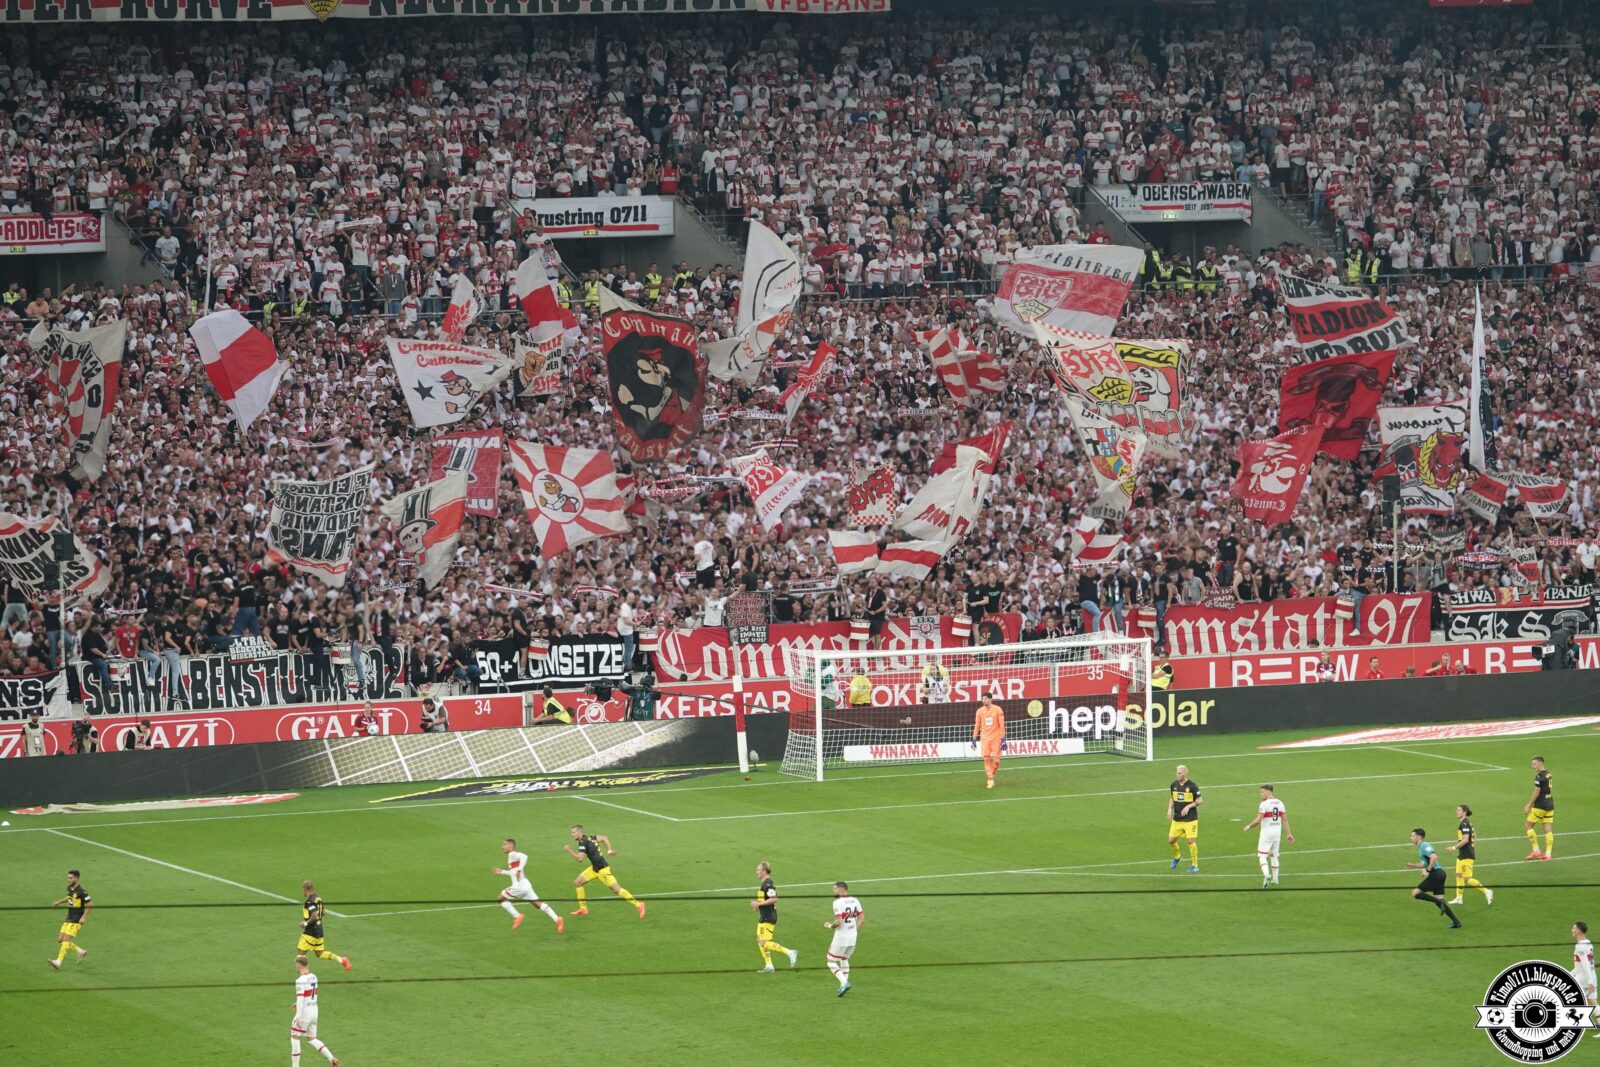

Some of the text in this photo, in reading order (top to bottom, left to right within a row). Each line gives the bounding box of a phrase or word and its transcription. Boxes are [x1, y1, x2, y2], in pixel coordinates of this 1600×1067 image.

[610, 204, 647, 223] 0711
[1367, 597, 1423, 647] 97
[230, 649, 277, 661] WIDERSTAND
[1087, 665, 1104, 681] 35
[475, 699, 492, 715] 34
[1048, 694, 1215, 740] hep solar
[869, 740, 1061, 759] WINAMAX INAMAX
[1272, 807, 1279, 821] 9
[845, 906, 858, 924] 24
[311, 982, 317, 1001] 7
